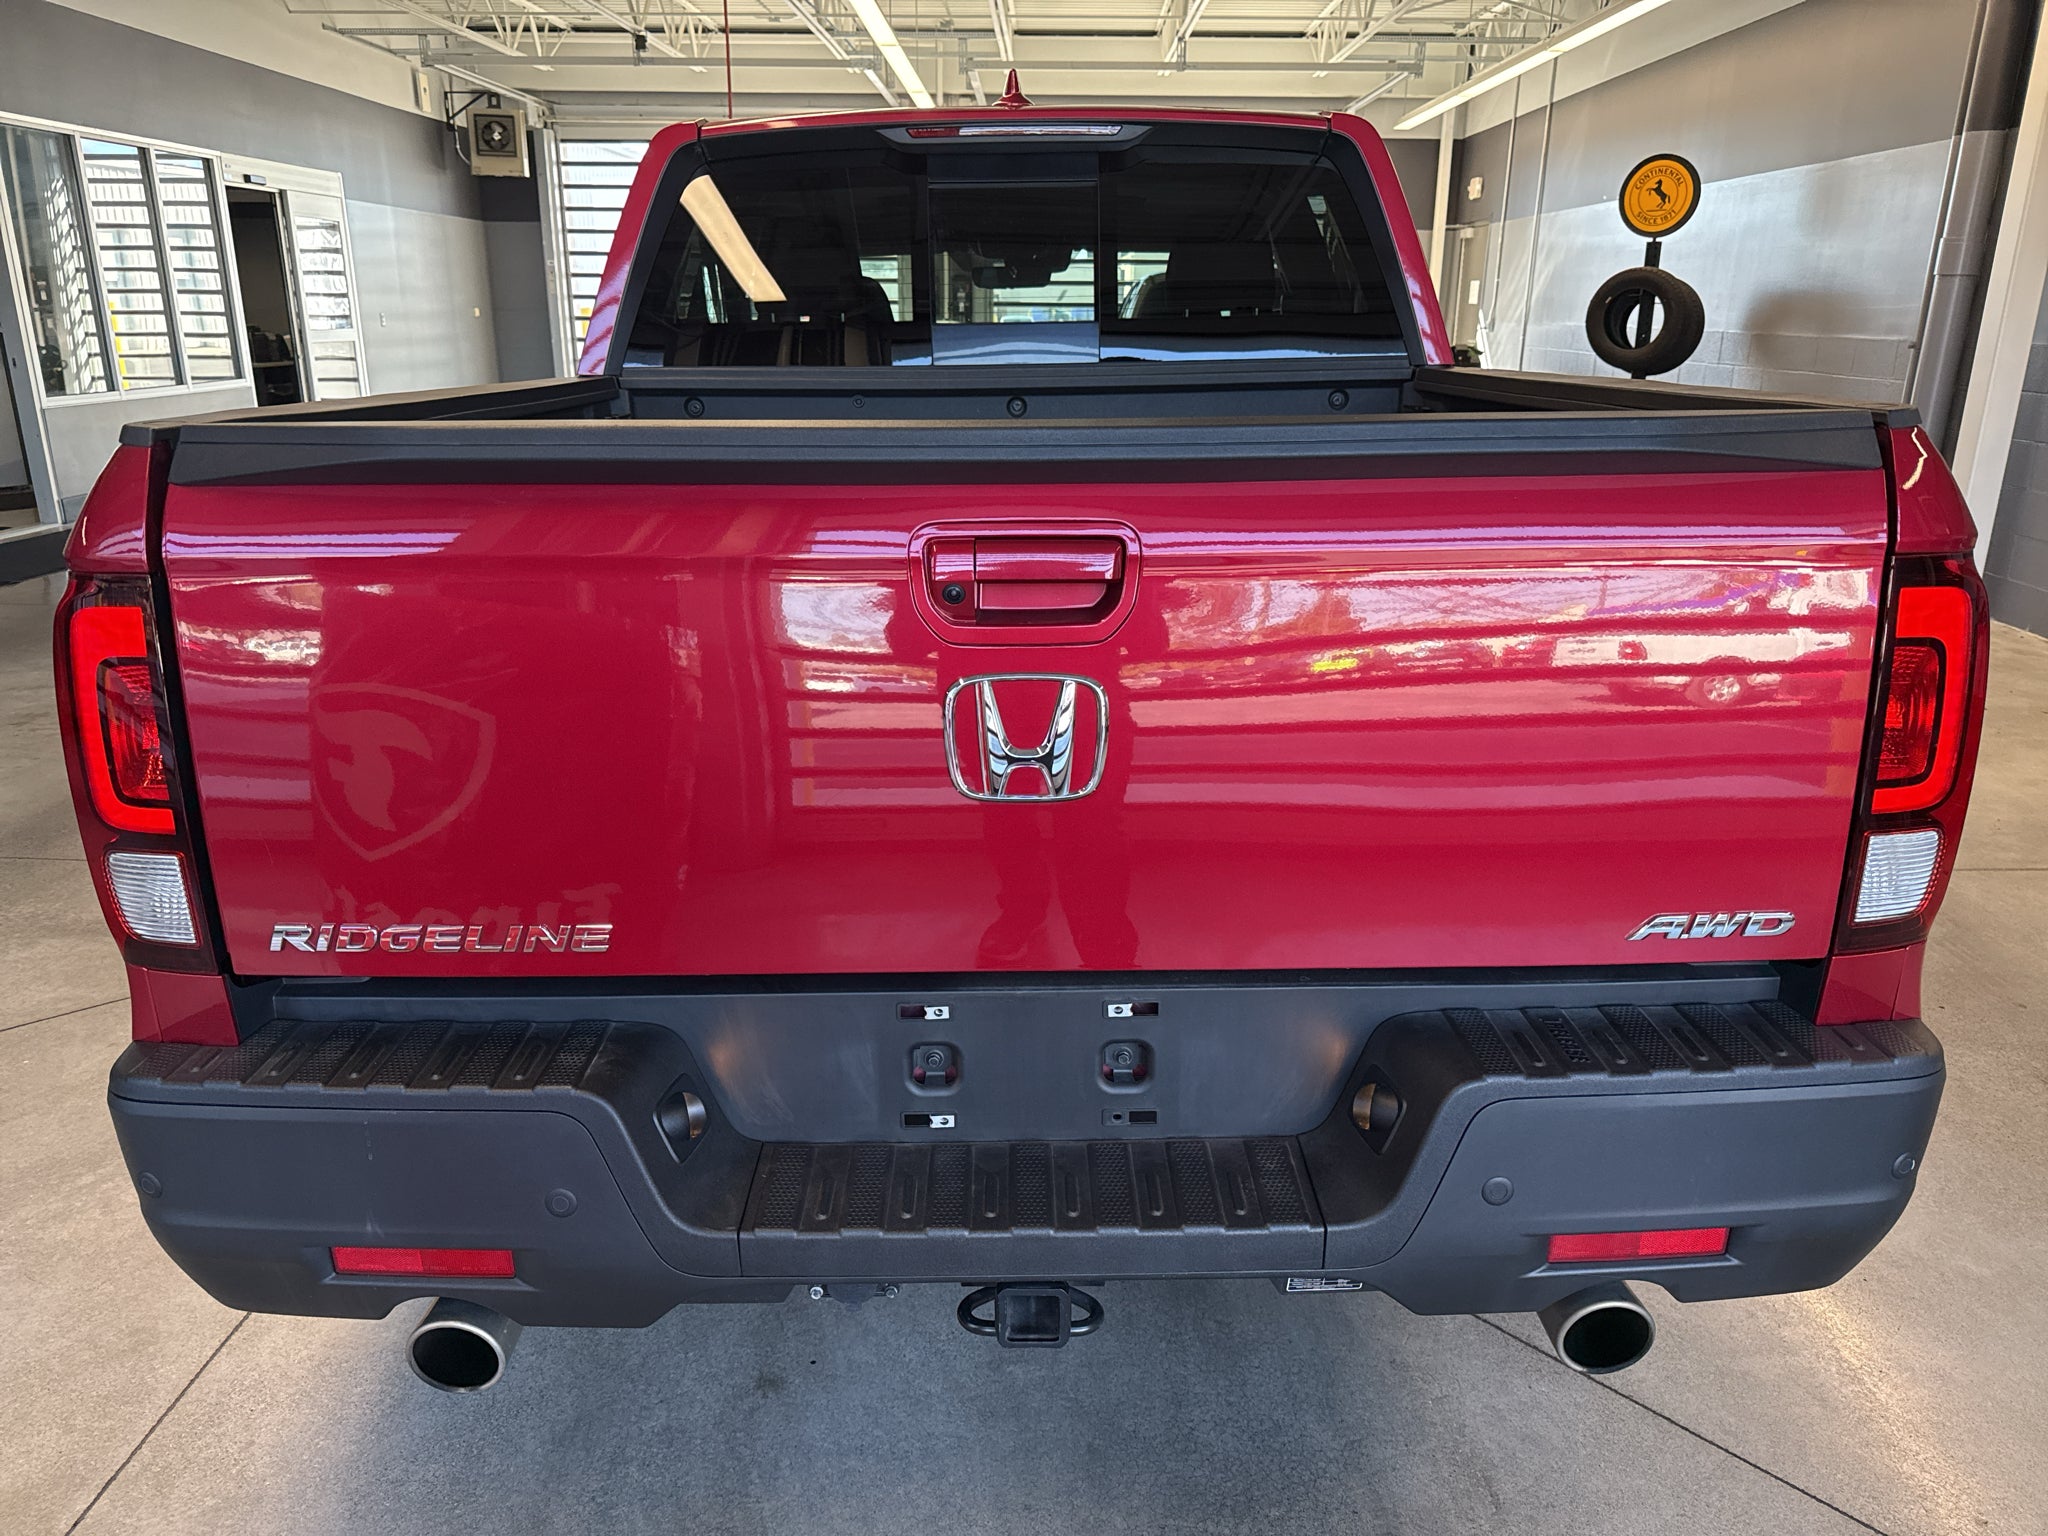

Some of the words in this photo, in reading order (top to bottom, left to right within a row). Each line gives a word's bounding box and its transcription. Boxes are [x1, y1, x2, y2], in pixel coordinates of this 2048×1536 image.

[1635, 167, 1684, 190] CONTINENTAL
[1635, 211, 1658, 225] SINCE
[1660, 209, 1677, 223] 1871
[269, 922, 613, 952] RIDGELINE
[1624, 911, 1796, 941] AWD
